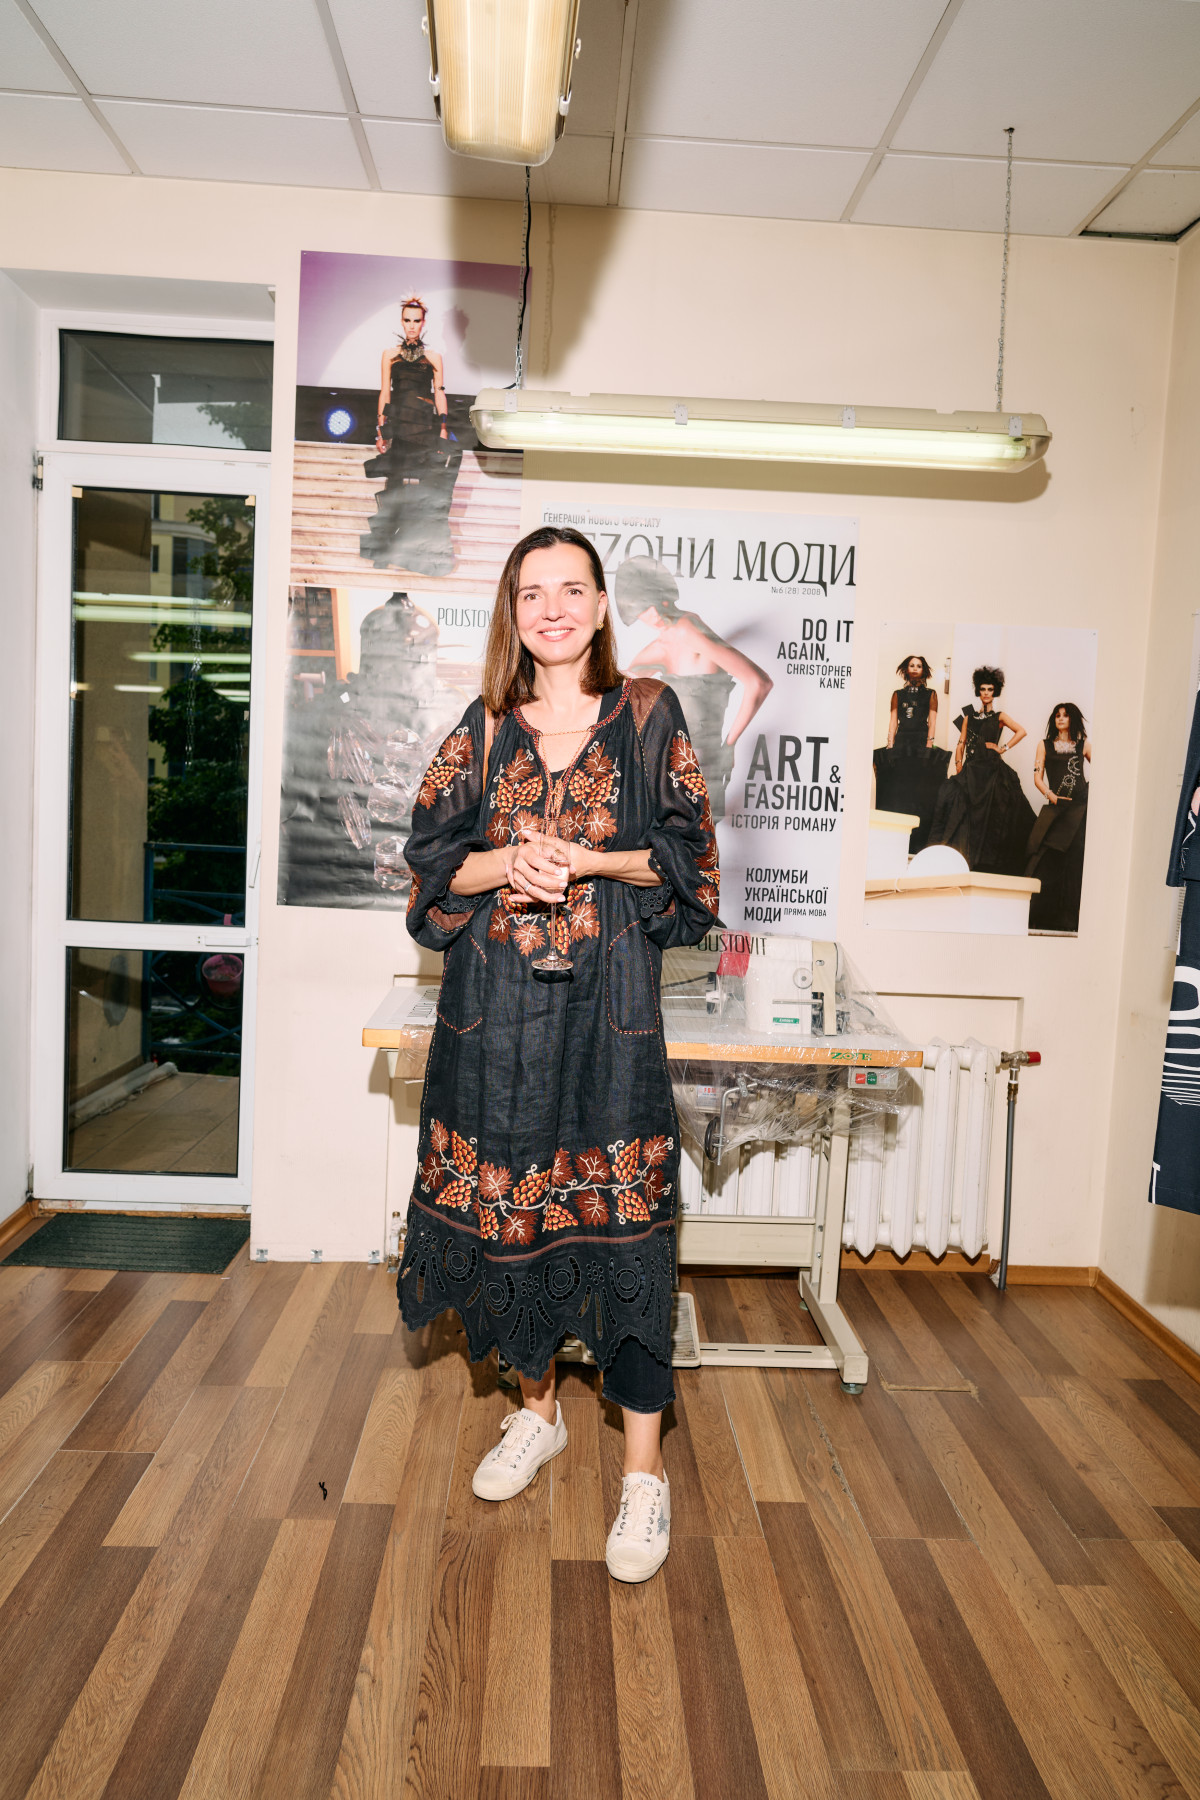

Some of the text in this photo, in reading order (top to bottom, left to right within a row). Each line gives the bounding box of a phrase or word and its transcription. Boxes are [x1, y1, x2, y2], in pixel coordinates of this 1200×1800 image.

[732, 540, 857, 597] МОДИ
[801, 588, 821, 596] 2008
[802, 618, 854, 643] DO IT
[777, 641, 830, 663] AGAIN,
[786, 663, 852, 677] CHRISTOPHER
[819, 677, 846, 689] KANE
[746, 733, 841, 784] ART &
[743, 782, 845, 813] FASHION:
[784, 816, 837, 832] РОМАНУ
[745, 867, 808, 884] КОЛУМБИ
[744, 885, 829, 904] УКРАЇНСЬКОЇ
[743, 906, 827, 924] МОДИ ПРЯМА МОВА
[689, 934, 767, 956] OUSTOVIT
